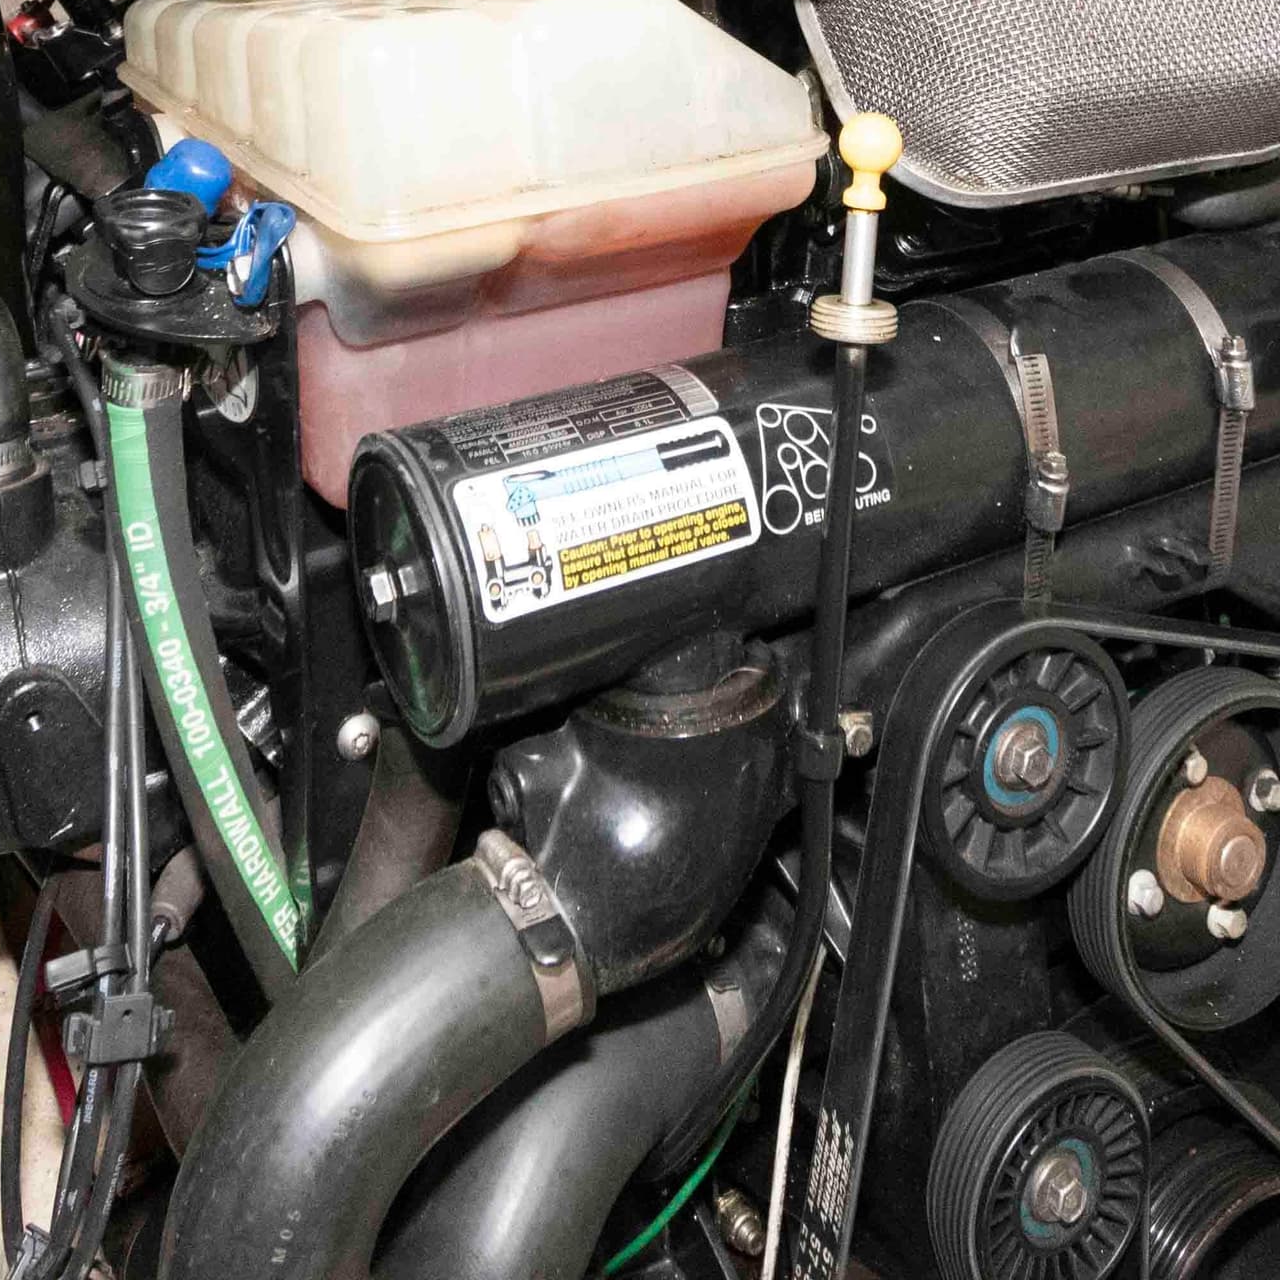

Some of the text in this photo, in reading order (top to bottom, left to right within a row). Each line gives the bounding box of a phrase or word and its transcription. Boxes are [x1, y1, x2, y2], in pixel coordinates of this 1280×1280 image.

[556, 483, 741, 544] WATER DRAIN PROCEDURE
[648, 479, 702, 501] MANUAL
[854, 488, 891, 510] UTING
[126, 520, 156, 553] ID
[560, 540, 608, 562] Caution:
[610, 531, 638, 549] Prior
[639, 526, 652, 540] to
[653, 511, 704, 538] operating
[603, 546, 626, 564] that
[627, 540, 656, 558] drain
[657, 529, 692, 548] valves
[693, 523, 711, 538] are
[712, 513, 747, 532] closed
[564, 575, 580, 590] by
[581, 562, 629, 584] opening
[629, 545, 670, 569] manual
[671, 538, 698, 557] relief
[156, 637, 216, 760] 100-0340
[206, 763, 282, 907] HARDWALL
